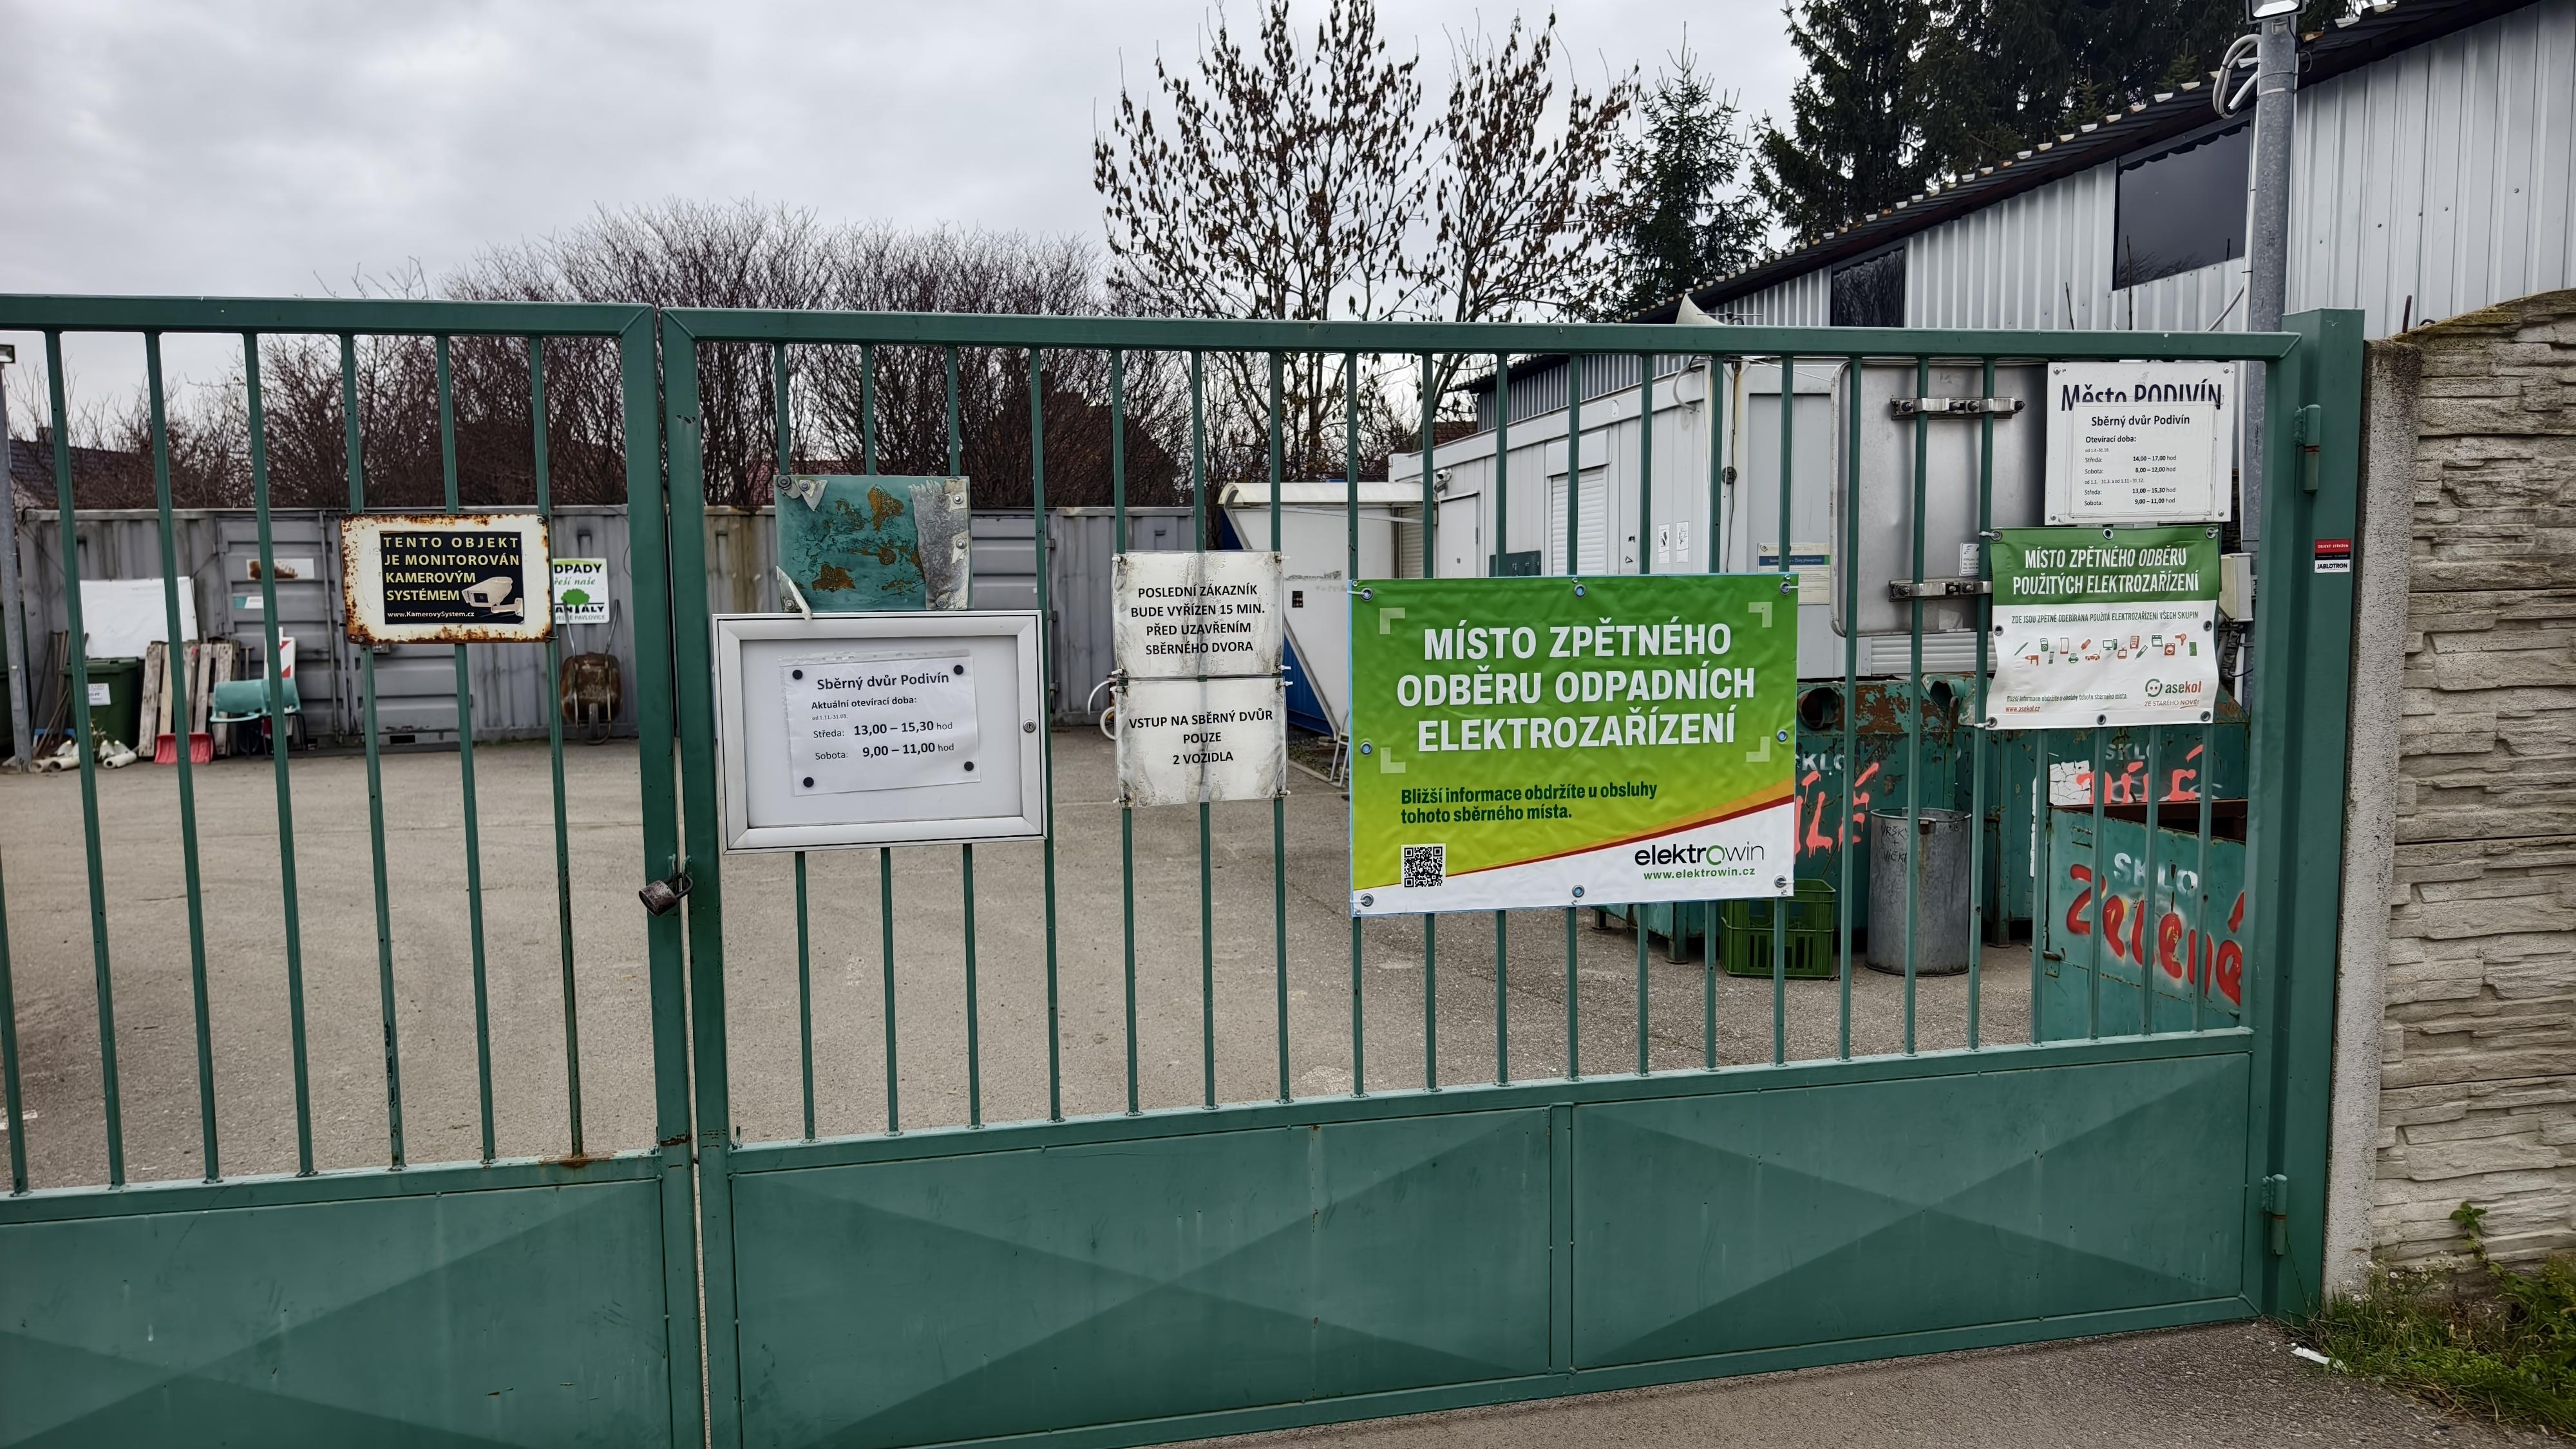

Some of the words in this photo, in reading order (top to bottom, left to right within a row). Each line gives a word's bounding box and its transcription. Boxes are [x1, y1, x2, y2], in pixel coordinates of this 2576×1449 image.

[2091, 415, 2126, 428] Sběrný
[2128, 415, 2152, 426] dvůr
[2154, 414, 2190, 425] Podivín
[384, 537, 442, 548] TENTO
[451, 537, 518, 548] OBJEKT
[384, 555, 400, 565] JE
[405, 553, 519, 565] MONITOROVÁN
[2025, 547, 2065, 569] MÍSTO
[2070, 545, 2136, 569] ZPĚTNÉHO
[2139, 545, 2187, 567] ODBĚRU
[386, 570, 476, 583] KAMEROVÝM
[554, 564, 601, 574] DPADY
[574, 576, 596, 585] naše
[2013, 573, 2083, 596] POUŽITÝCH
[2087, 569, 2199, 594] ELEKTROZAŘÍZENÍ
[387, 588, 459, 601] SYSTÉMEM
[1138, 584, 1197, 598] POSLEDNÍ
[1200, 583, 1257, 596] ZÁKAZNÍK
[1131, 606, 1164, 618] BUDE
[1167, 603, 1217, 616] VYŘÍZEN
[1220, 605, 1233, 615] 15
[1236, 603, 1265, 614] MIN.
[2023, 615, 2036, 623] JSOU
[2112, 611, 2159, 621] ELEKTROZAŘÍZENÍ
[2159, 611, 2176, 620] VŠECH
[1146, 623, 1177, 636] PŘED
[1181, 621, 1251, 635] UZAVŘENÍM
[1424, 620, 1537, 660] MÍSTO
[1549, 616, 1731, 658] ZPĚTNÉHO
[1146, 641, 1209, 655] SBĚRNÉHO
[1213, 641, 1253, 652] DVORA
[817, 677, 863, 692] Sběrný
[867, 674, 897, 688] dvůr
[901, 672, 949, 686] Podivín
[1396, 665, 1541, 707] ODBĚRU
[1555, 661, 1755, 703] ODPADNÍCH
[2164, 680, 2202, 694] asekol
[811, 699, 849, 710] Aktuální
[851, 697, 889, 708] otevírací
[892, 696, 917, 705] doba:
[1129, 717, 1168, 729] VSTUP
[1171, 715, 1189, 726] NA
[1191, 710, 1235, 725] SBĚRNÝ
[1239, 708, 1273, 722] DVŮR
[813, 729, 845, 739] Středa:
[854, 724, 887, 736] 13,00
[902, 721, 934, 734] 15,30
[936, 722, 953, 730] hod
[1418, 705, 1735, 752] ELEKTROZAŘÍZENÍ
[1183, 732, 1222, 744] POUZE
[815, 751, 849, 761] Sobota:
[862, 745, 889, 759] 9,00
[903, 743, 934, 755] 11,00
[938, 743, 954, 752] hod
[1173, 754, 1180, 765] 2
[1183, 751, 1234, 764] VOZIDLA
[1795, 753, 1845, 771] KLO
[1401, 787, 1443, 805] Bližší
[1446, 785, 1522, 804] informace
[1524, 783, 1586, 801] obdržíte
[1588, 786, 1598, 799] u
[1600, 782, 1658, 802] obsluhy
[1401, 809, 1451, 825] tohoto
[1454, 805, 1524, 823] sběrného
[1526, 804, 1572, 820] místa.
[1634, 841, 1765, 867] elektrowin
[1643, 867, 1756, 881] www.elektrowin.cz
[2113, 852, 2199, 898] SKLO
